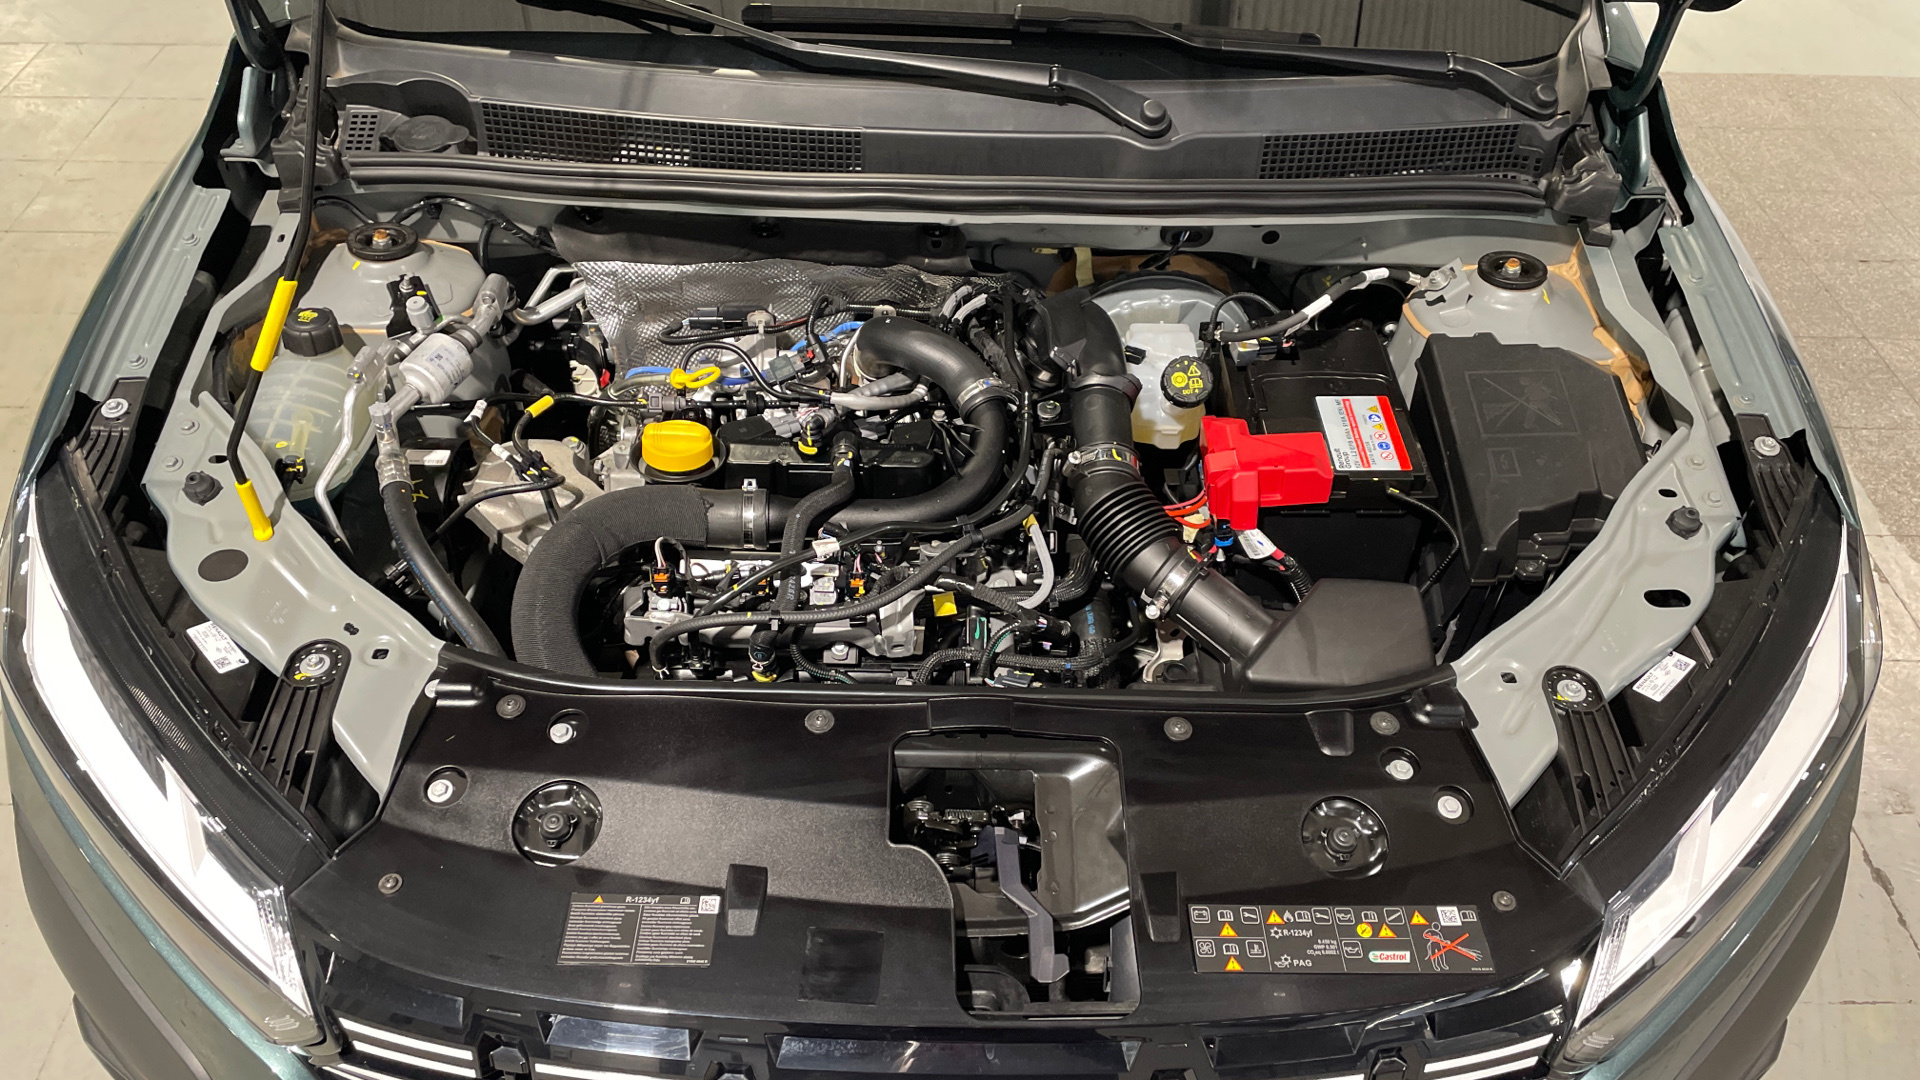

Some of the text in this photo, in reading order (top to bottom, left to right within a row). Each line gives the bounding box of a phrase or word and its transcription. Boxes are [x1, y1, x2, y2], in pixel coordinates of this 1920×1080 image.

[1334, 448, 1344, 468] Renault
[1343, 452, 1351, 468] Group
[1636, 672, 1653, 690] RENAULT
[625, 896, 660, 904] R-1234yf
[1283, 929, 1313, 938] R-1234yf
[1379, 953, 1407, 961] Castrol
